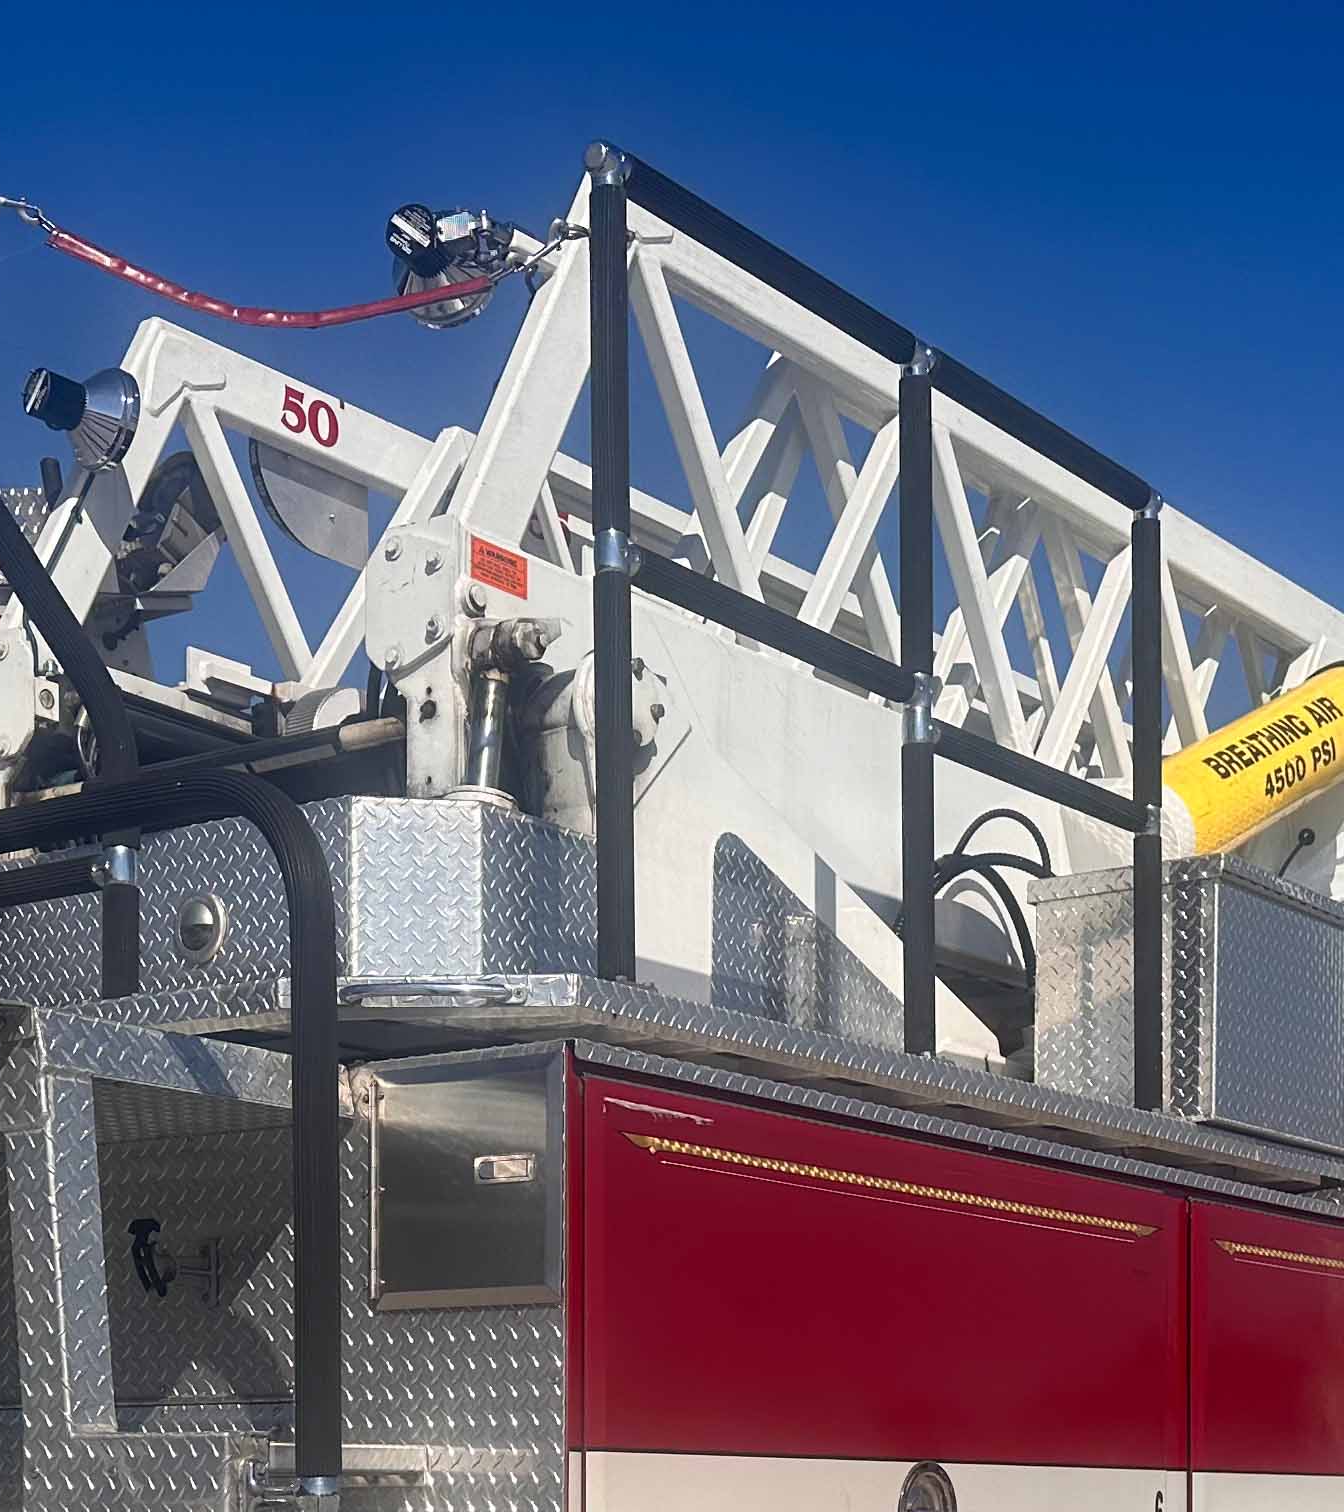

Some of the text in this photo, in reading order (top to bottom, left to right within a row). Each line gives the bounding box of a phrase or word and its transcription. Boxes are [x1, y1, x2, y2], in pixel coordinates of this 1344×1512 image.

[281, 384, 339, 447] 50
[1202, 696, 1344, 780] BREATHING AIR
[1265, 736, 1337, 799] 4500 PSI
